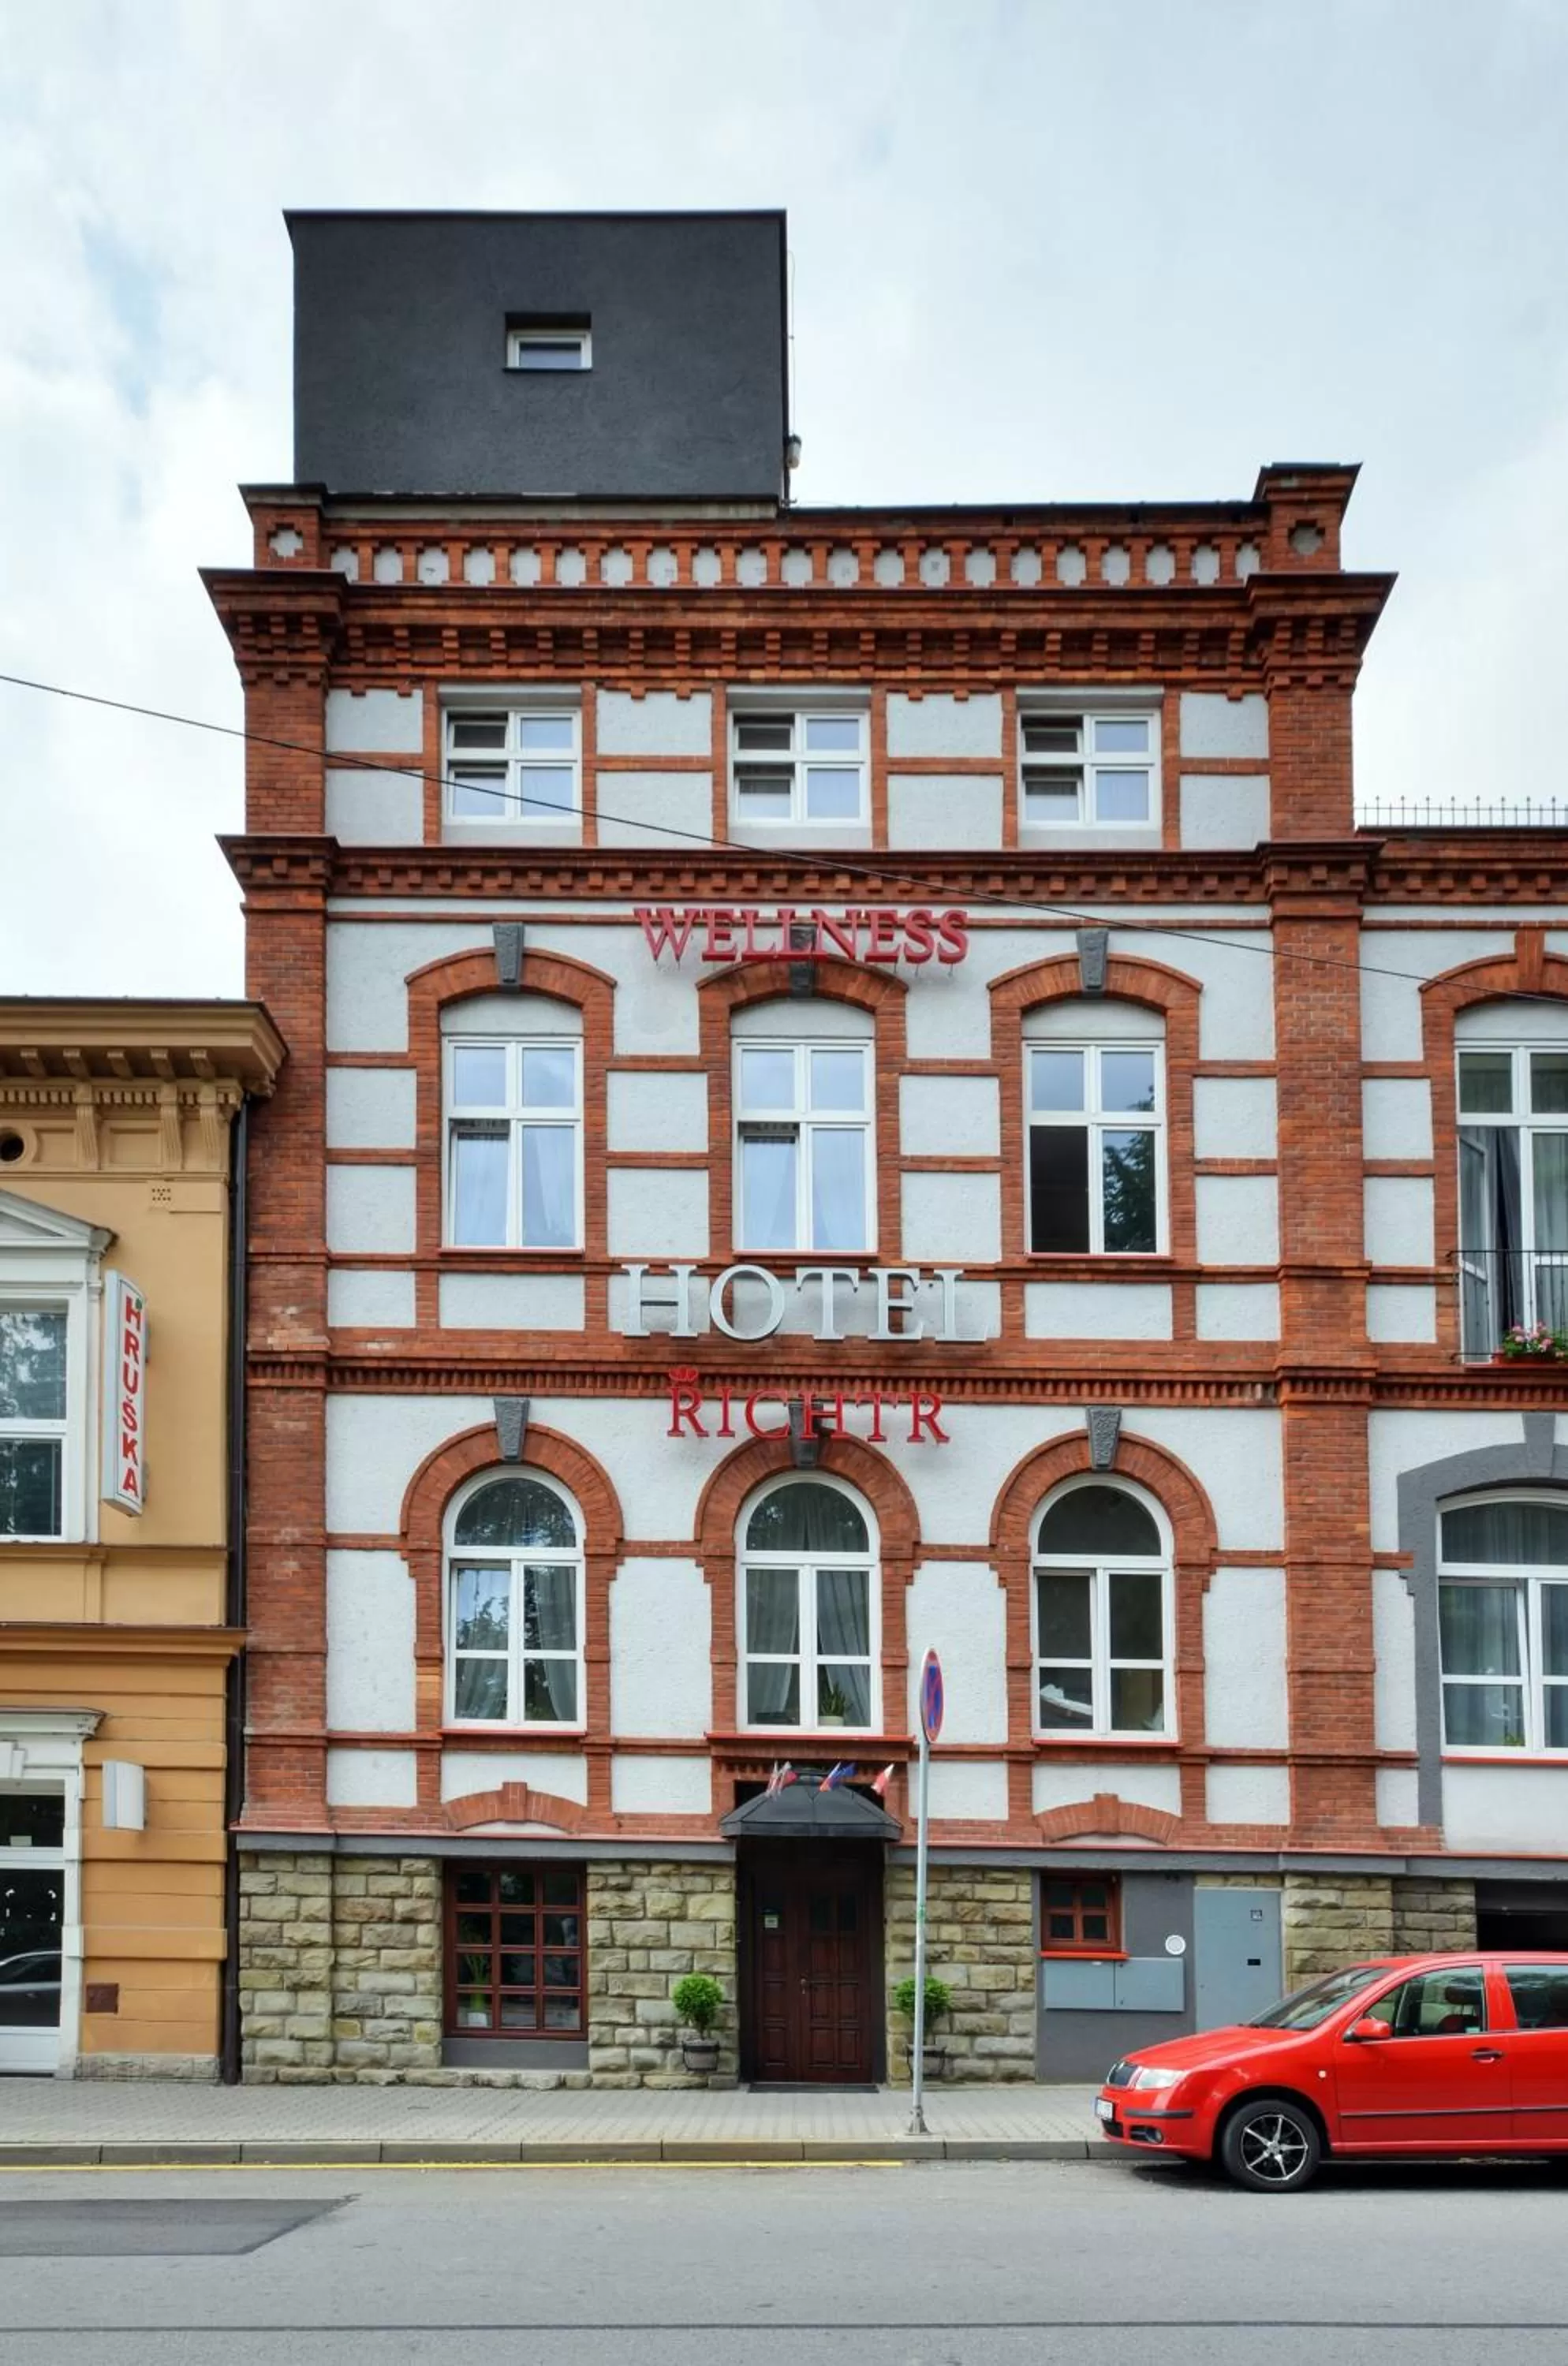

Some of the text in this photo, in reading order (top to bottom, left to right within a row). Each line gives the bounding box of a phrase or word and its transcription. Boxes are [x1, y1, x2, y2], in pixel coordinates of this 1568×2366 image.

[633, 909, 969, 964] WELLNESS
[622, 1264, 987, 1342] HOTEL
[667, 1386, 950, 1442] RICHTR
